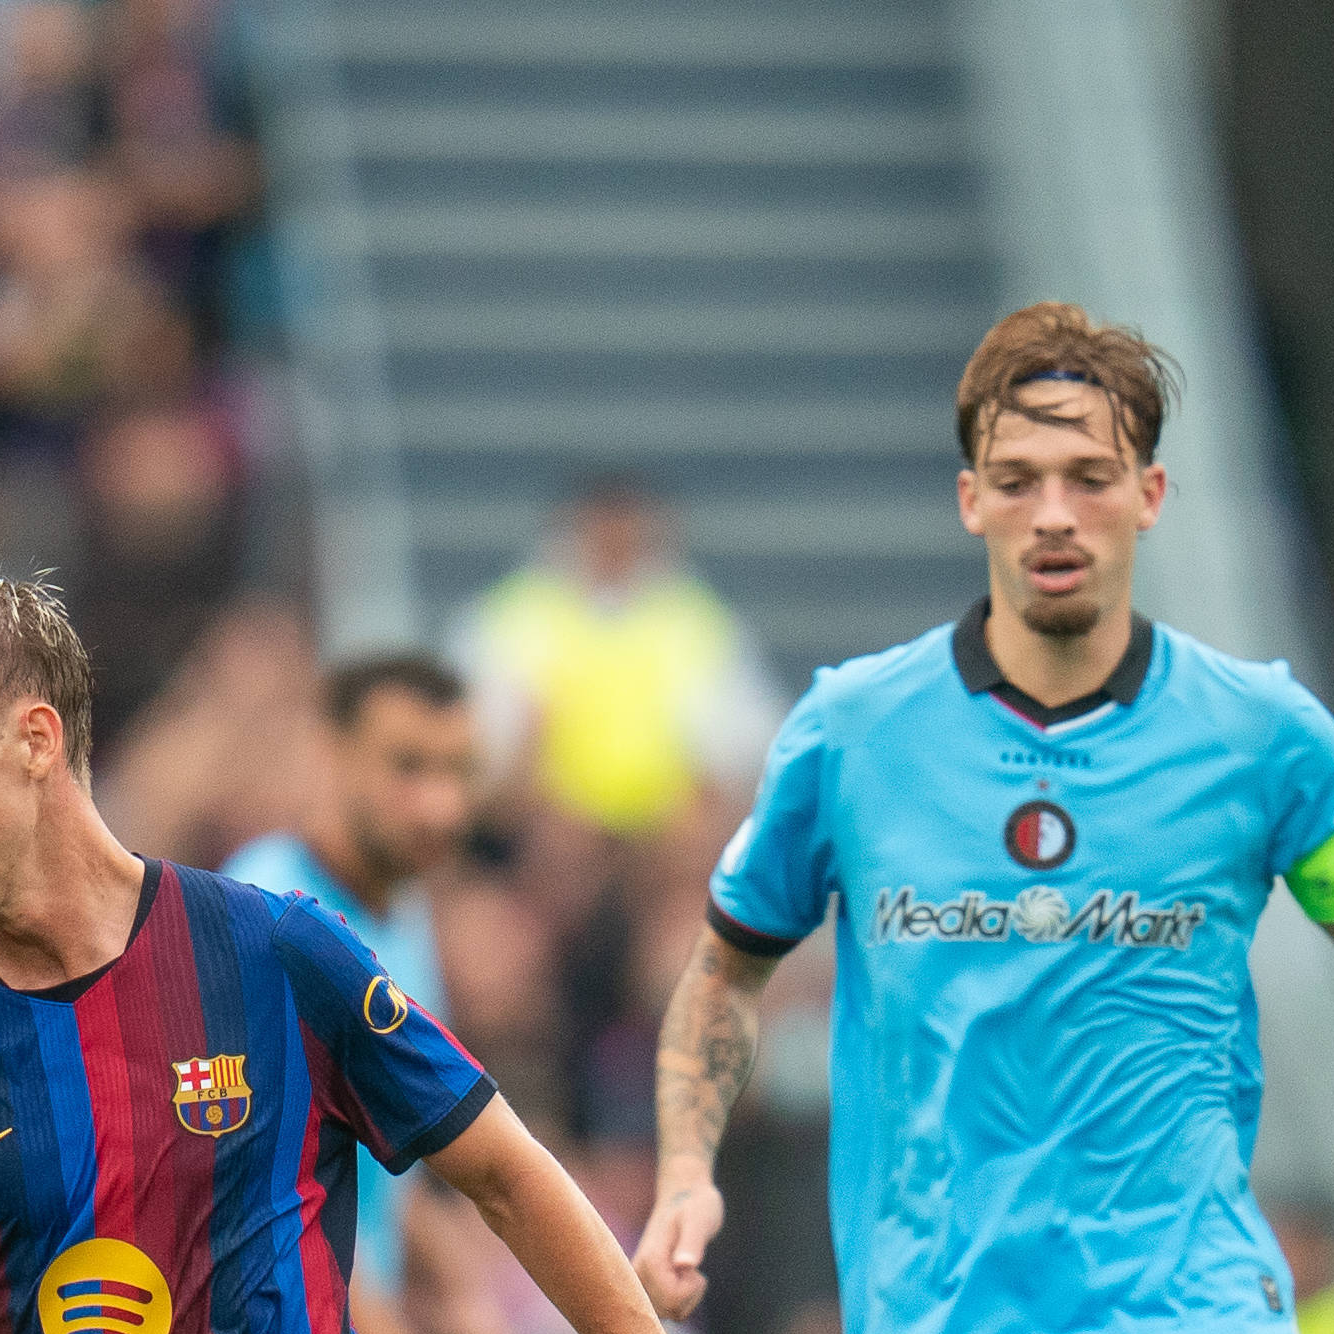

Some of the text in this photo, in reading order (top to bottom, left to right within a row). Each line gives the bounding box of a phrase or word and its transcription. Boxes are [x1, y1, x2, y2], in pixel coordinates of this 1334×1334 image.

[869, 887, 1203, 949] Media Markt
[197, 1088, 228, 1100] FCB
